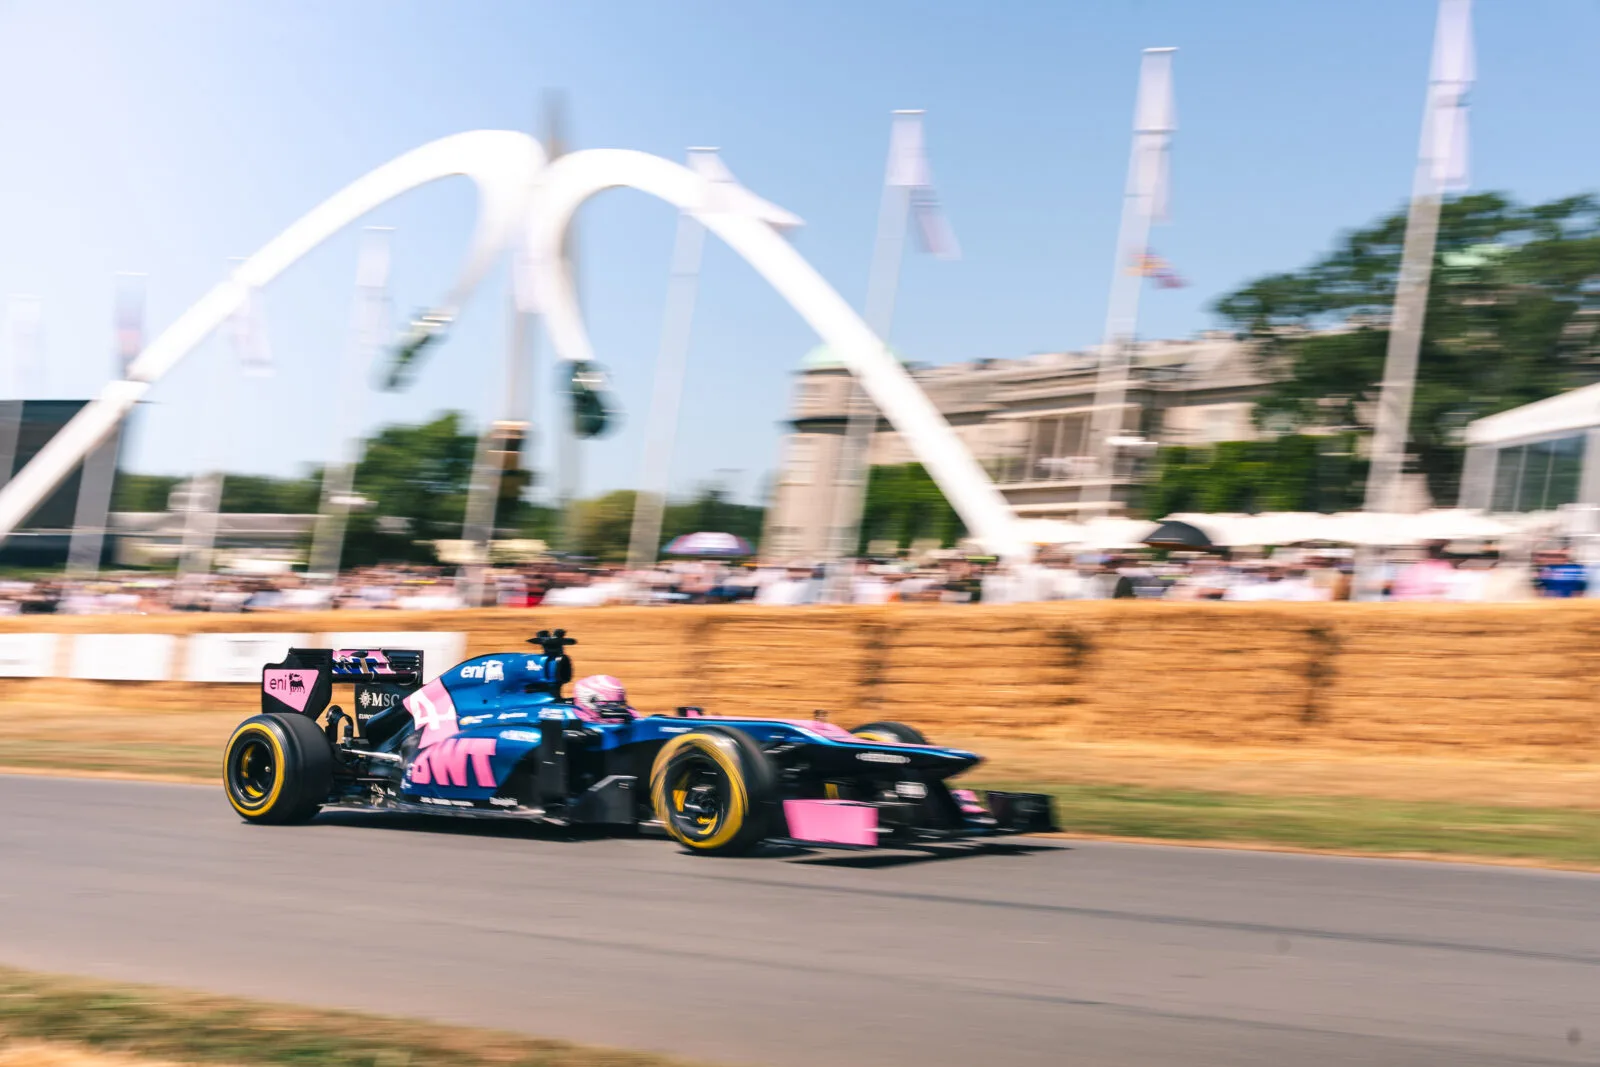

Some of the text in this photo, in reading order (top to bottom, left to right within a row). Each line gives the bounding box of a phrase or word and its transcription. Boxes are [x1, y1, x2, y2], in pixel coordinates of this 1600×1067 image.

[460, 661, 487, 679] eni
[269, 675, 287, 690] eni
[371, 692, 400, 708] MSC
[411, 738, 497, 788] BWT
